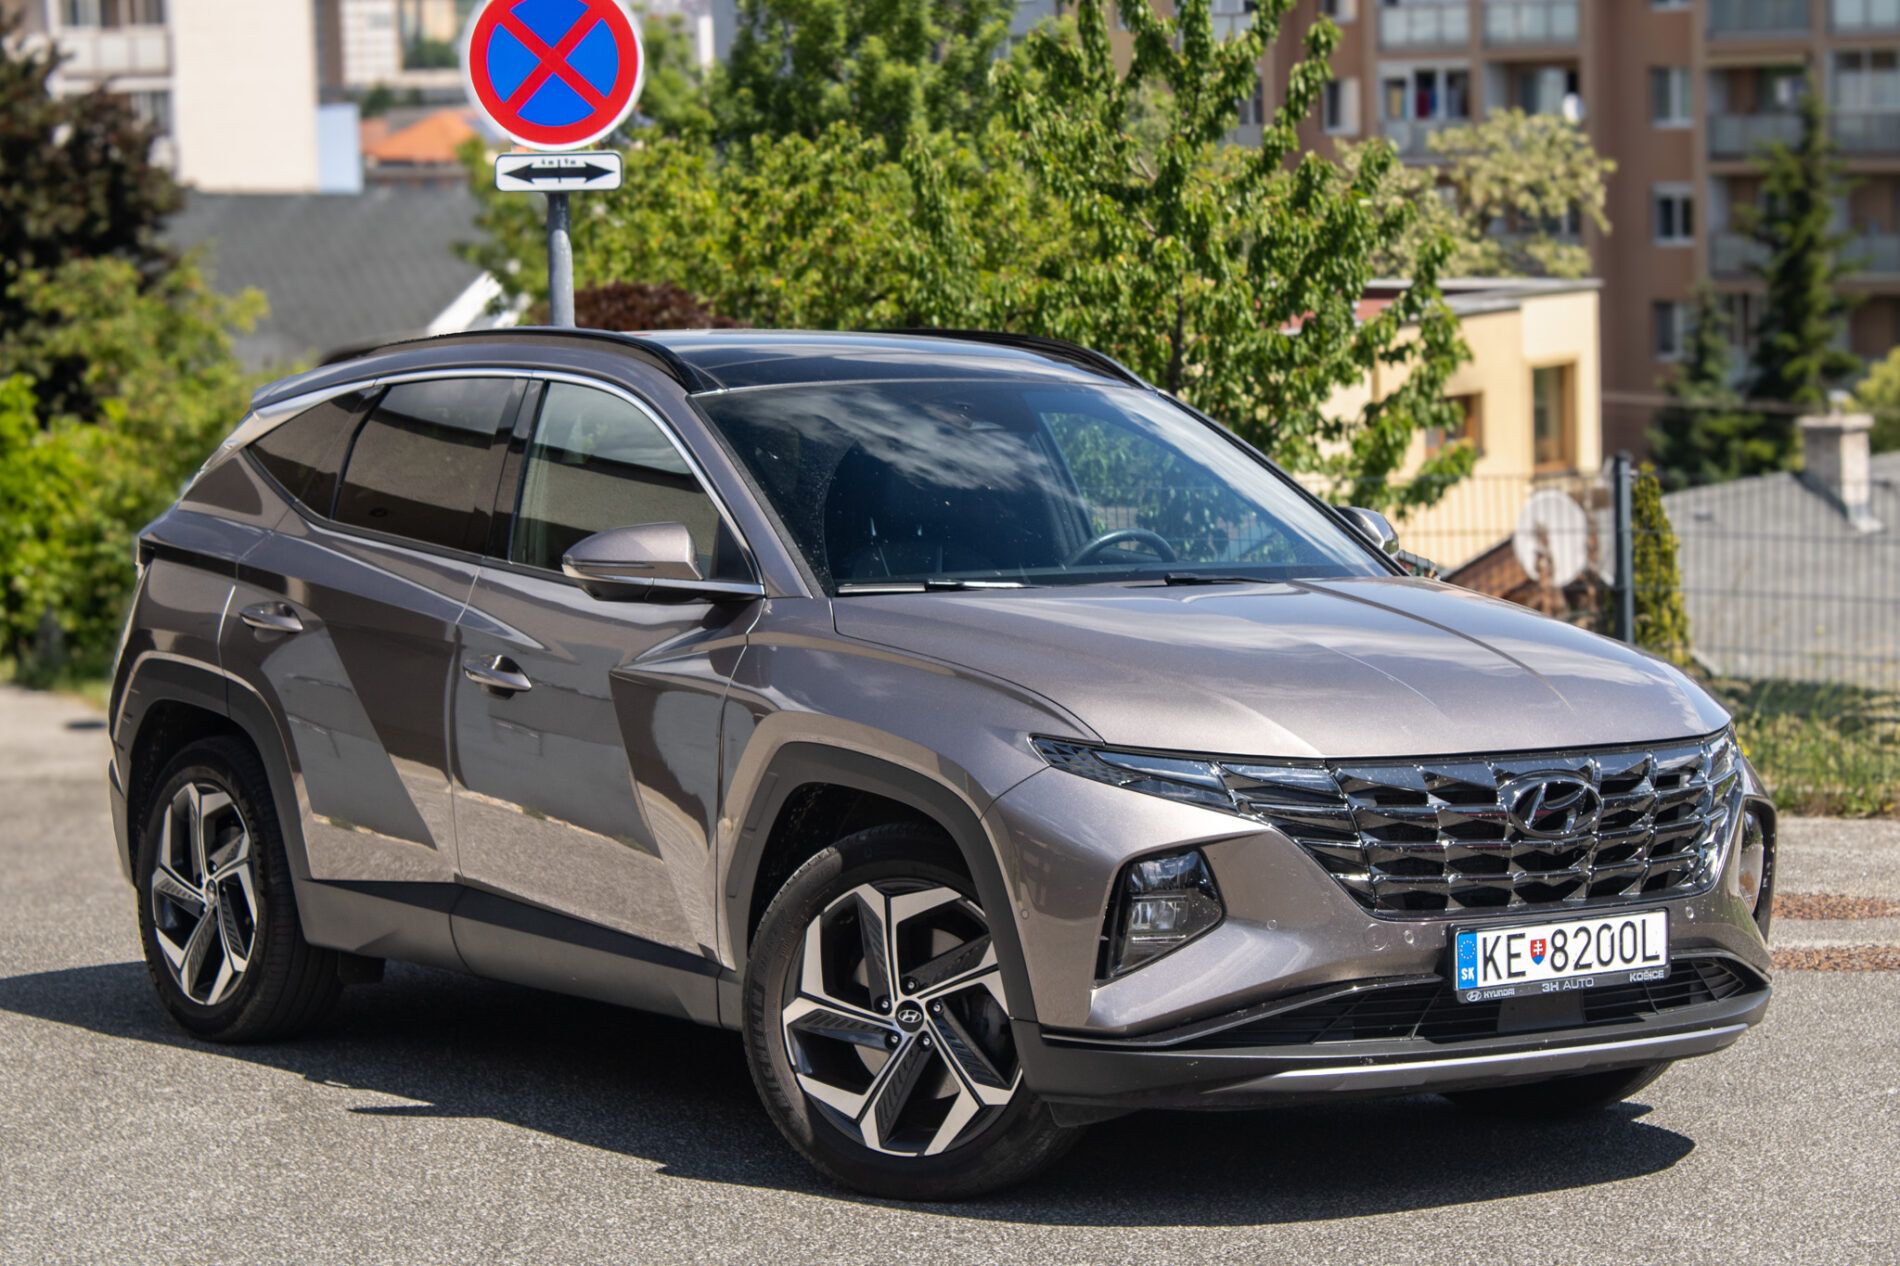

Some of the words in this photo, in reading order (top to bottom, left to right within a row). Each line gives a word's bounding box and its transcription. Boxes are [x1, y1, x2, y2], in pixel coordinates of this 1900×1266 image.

[1482, 932, 1526, 982] KE
[1551, 918, 1660, 972] 8200L
[1461, 966, 1475, 981] SK
[1483, 987, 1515, 999] HYUNDAI
[1542, 981, 1560, 992] 3H
[1562, 977, 1595, 991] AUTO
